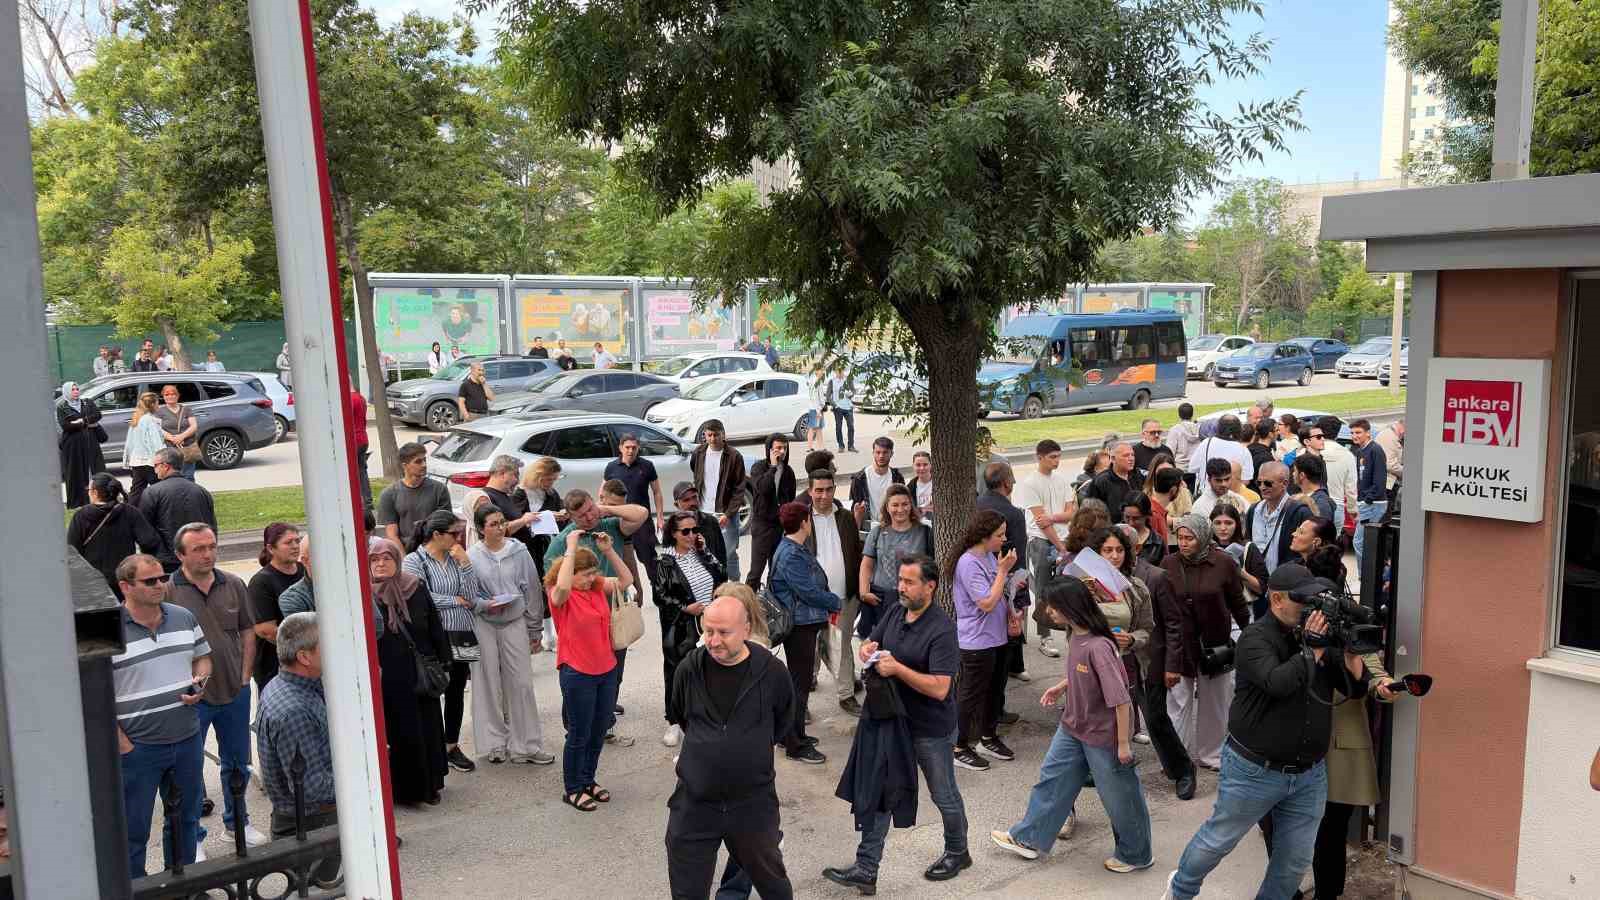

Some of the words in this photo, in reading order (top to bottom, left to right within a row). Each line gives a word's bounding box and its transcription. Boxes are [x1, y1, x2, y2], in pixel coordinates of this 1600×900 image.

[1447, 395, 1510, 411] ankara
[1448, 464, 1511, 482] HUKUK
[1431, 481, 1528, 502] FAKÜLTESİ
